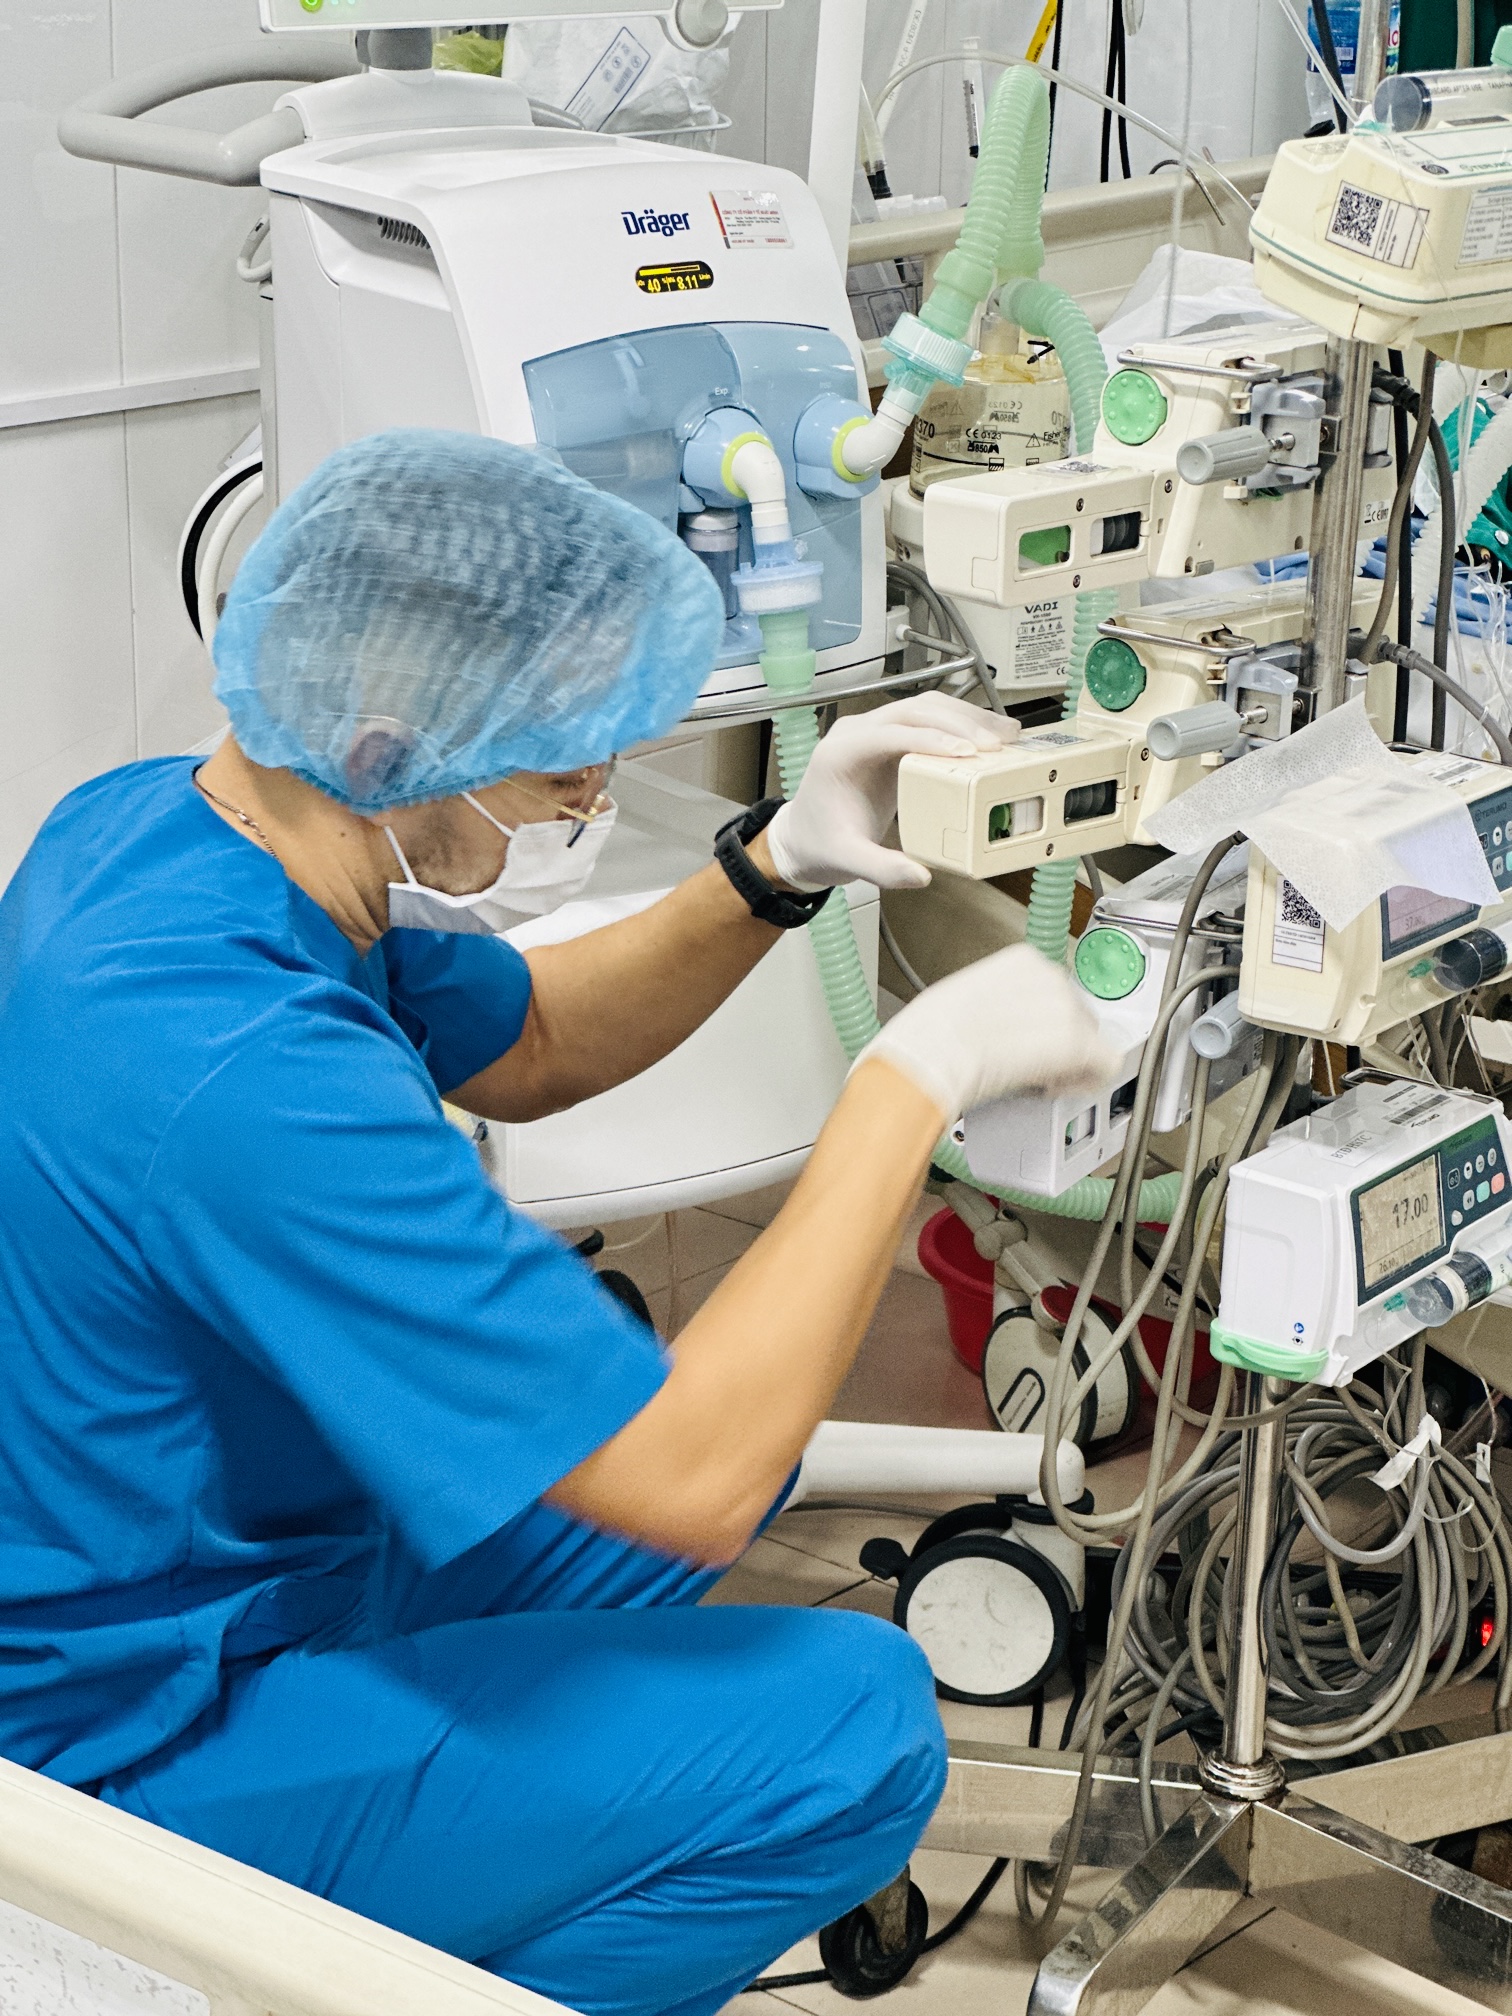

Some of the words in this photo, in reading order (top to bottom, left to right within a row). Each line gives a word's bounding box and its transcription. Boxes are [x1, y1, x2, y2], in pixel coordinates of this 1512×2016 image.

[621, 208, 690, 237] Dräger
[647, 278, 661, 293] 40
[677, 274, 699, 290] 8.11
[714, 387, 728, 396] Exp
[980, 431, 1002, 440] 0123
[1024, 601, 1058, 614] VADI
[1392, 1193, 1429, 1229] 17.00
